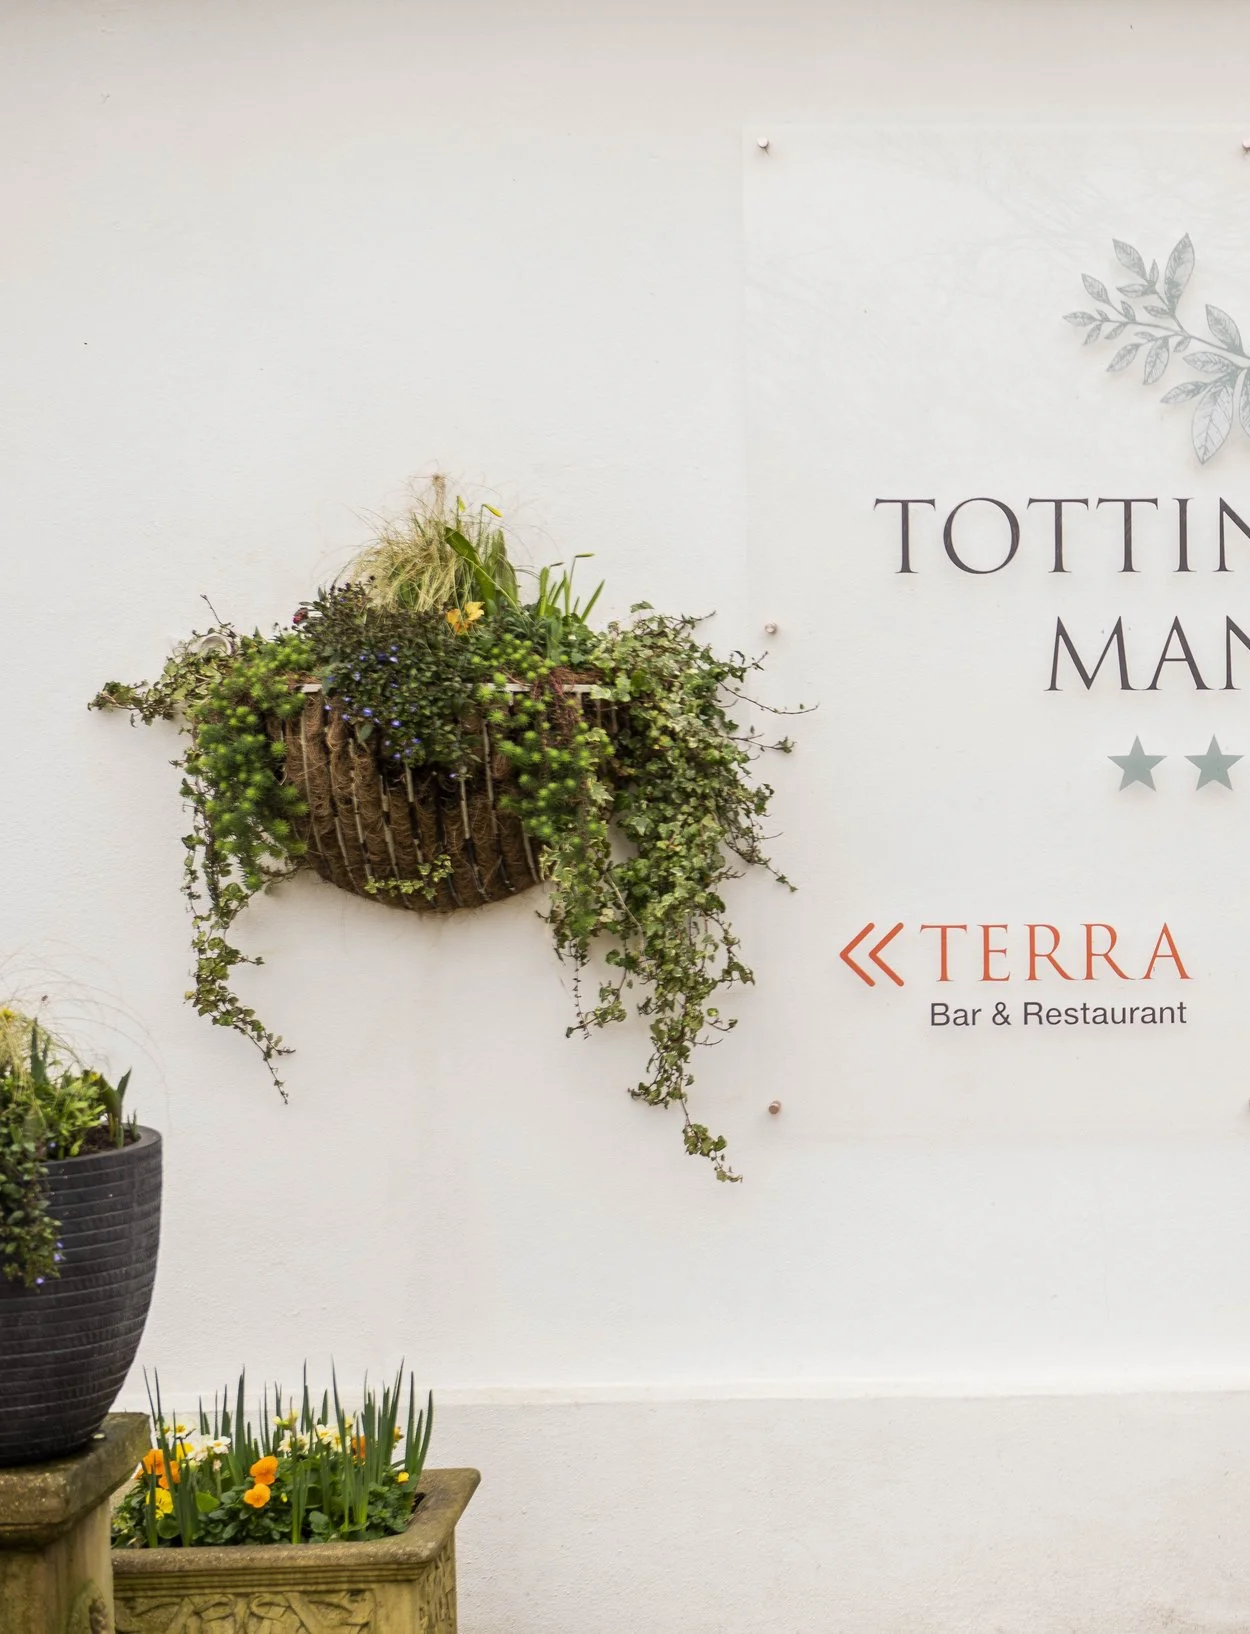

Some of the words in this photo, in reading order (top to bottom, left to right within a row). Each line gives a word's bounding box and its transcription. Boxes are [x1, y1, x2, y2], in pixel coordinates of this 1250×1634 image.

[919, 922, 1192, 982] TERRA
[930, 1001, 981, 1026] Bar
[991, 1002, 1011, 1027] &
[1022, 1001, 1187, 1026] Restaurant
